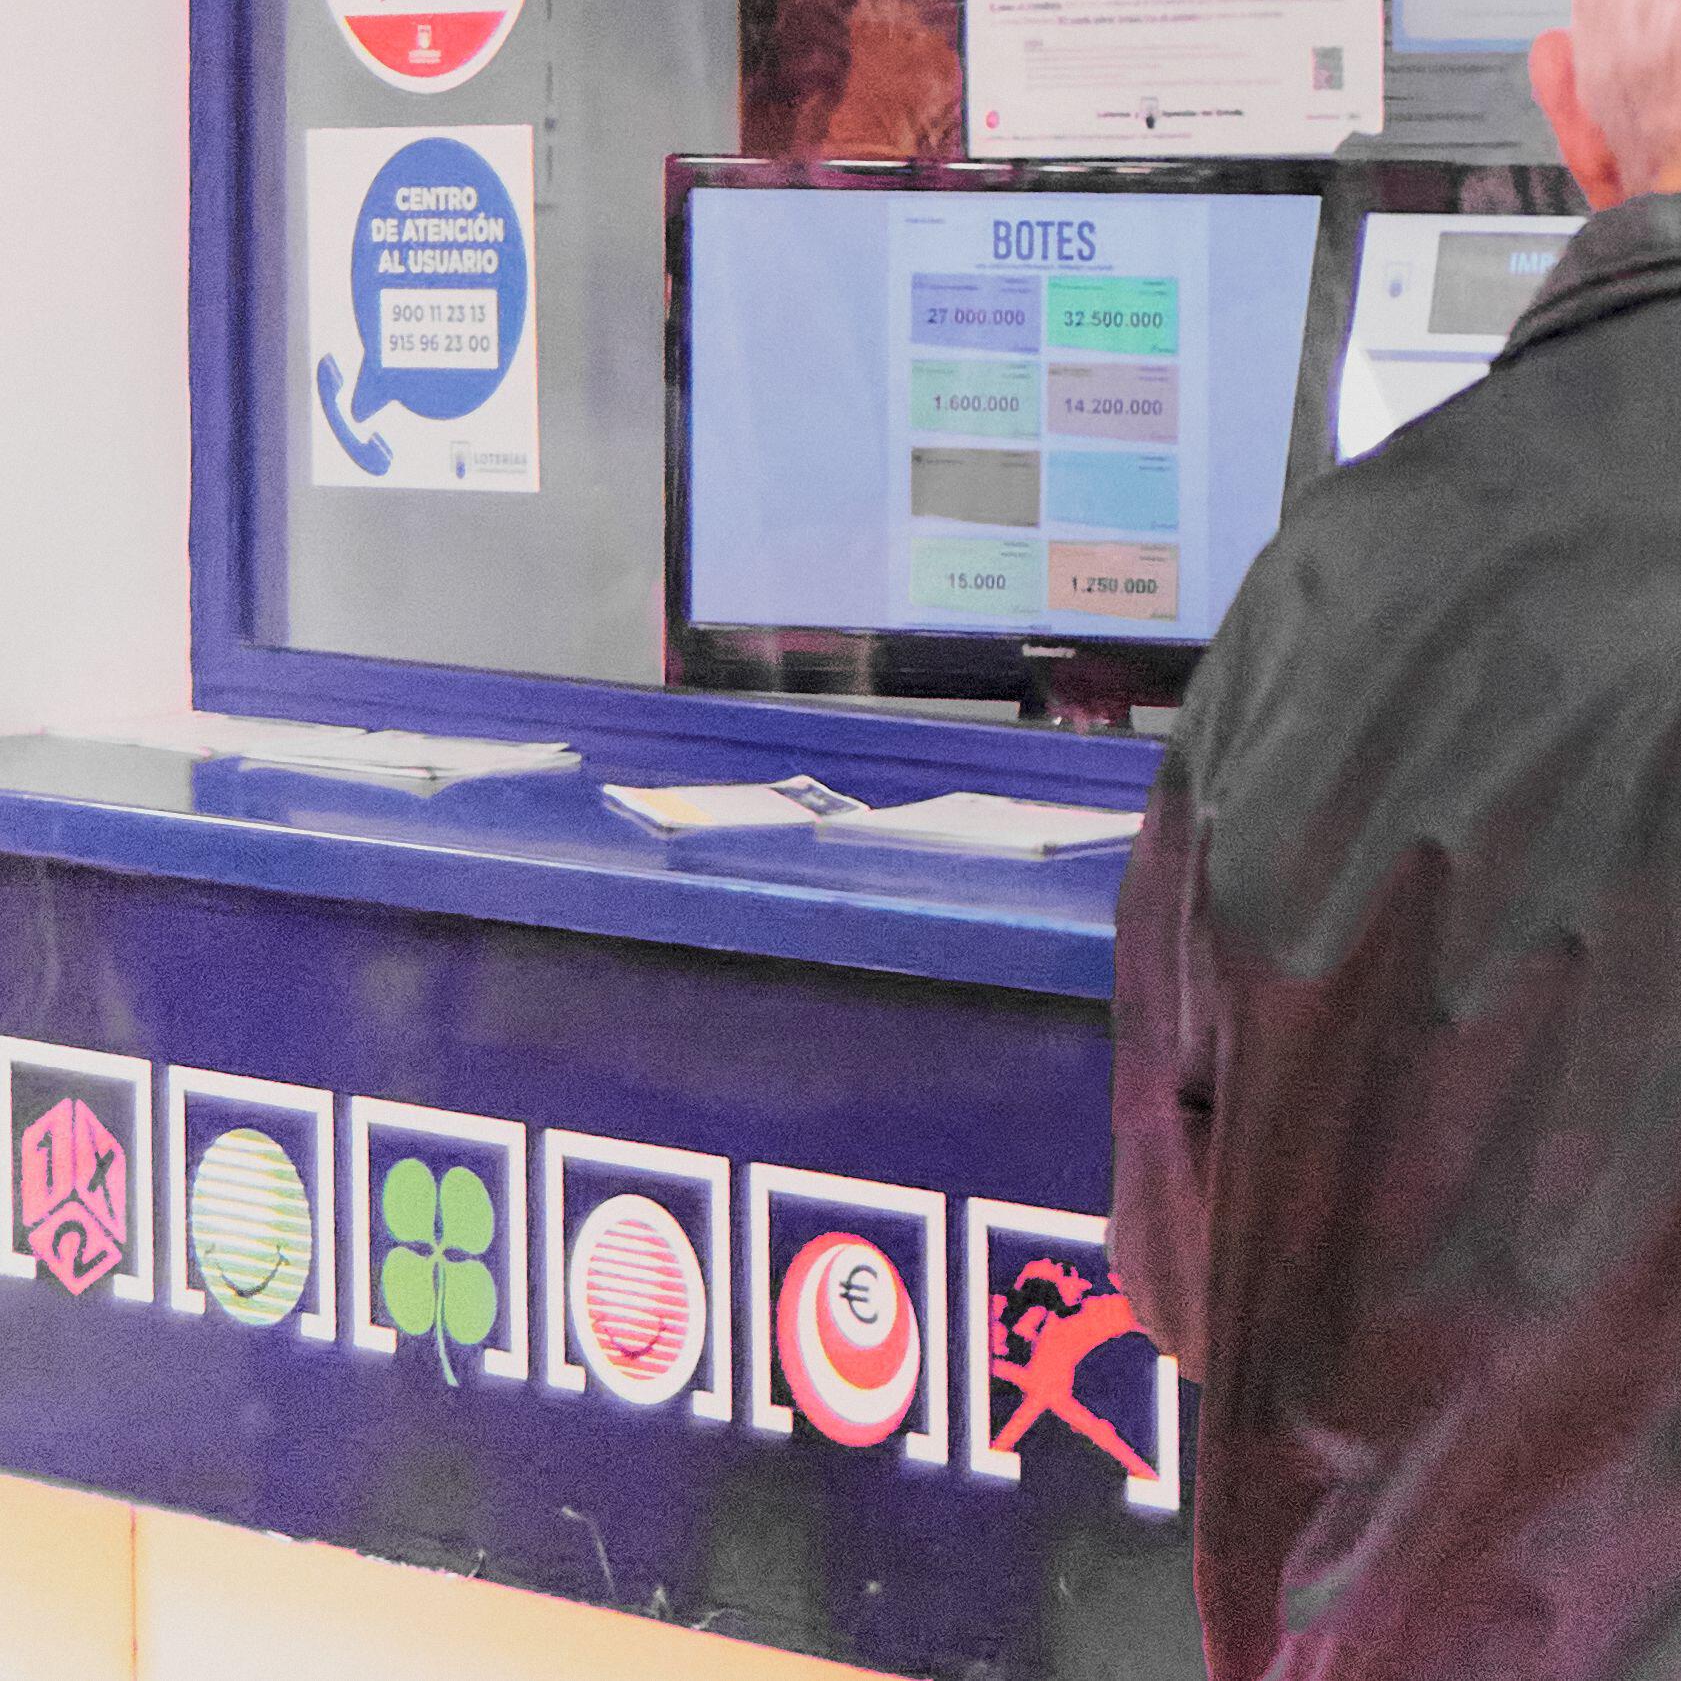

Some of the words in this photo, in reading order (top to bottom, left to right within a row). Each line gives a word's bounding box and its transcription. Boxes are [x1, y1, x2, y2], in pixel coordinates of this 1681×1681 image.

[395, 186, 478, 211] CENTRO
[371, 219, 397, 243] DE
[402, 213, 505, 243] ATENCIÓN
[992, 220, 1097, 262] BOTES
[378, 251, 405, 274] AL
[408, 249, 499, 274] USUARIO
[392, 304, 424, 322] 900
[429, 304, 442, 321] 11
[446, 304, 465, 321] 23
[470, 304, 486, 321] 13
[389, 335, 416, 352] 915
[420, 335, 440, 352] 96
[444, 336, 463, 353] 23
[468, 336, 490, 353] 00
